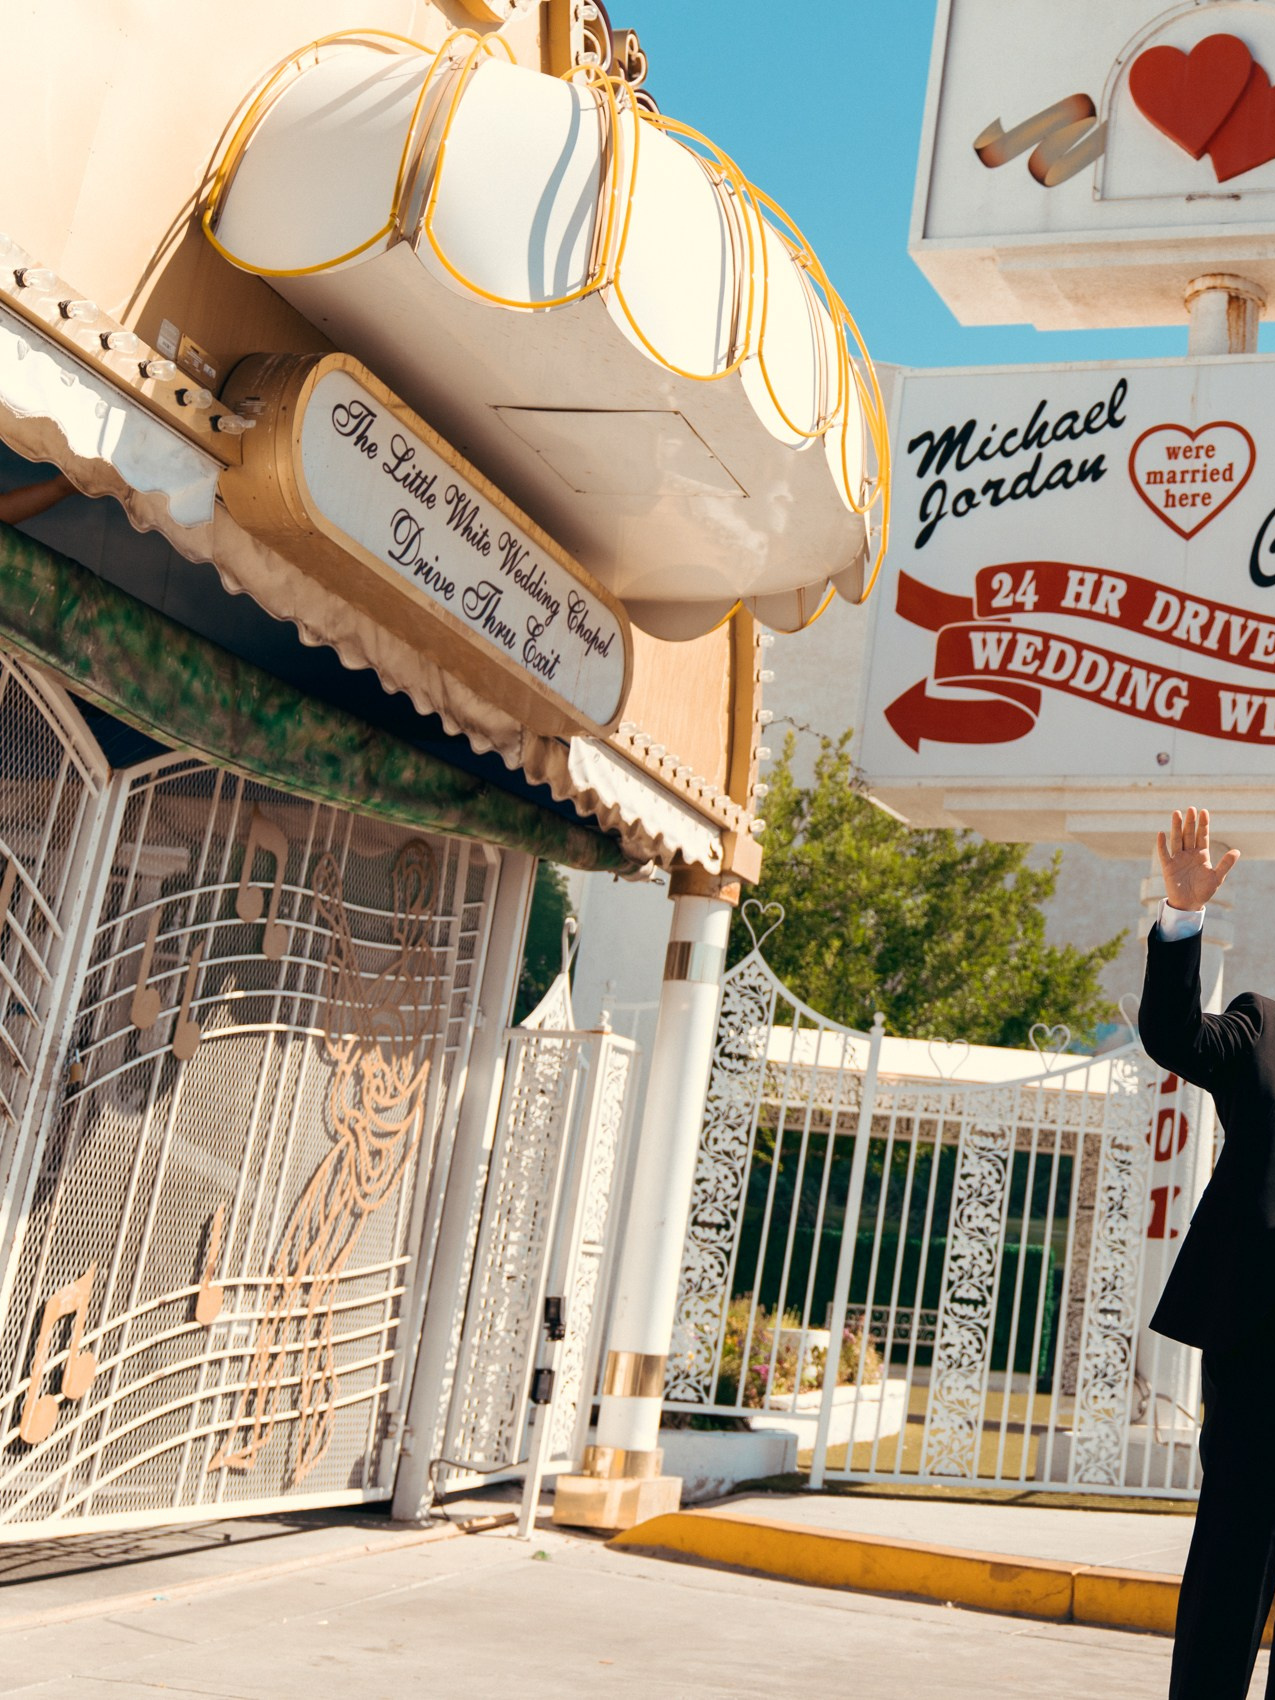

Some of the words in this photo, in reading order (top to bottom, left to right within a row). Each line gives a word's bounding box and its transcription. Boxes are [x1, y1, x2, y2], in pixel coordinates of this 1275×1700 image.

[907, 378, 1128, 479] Michael
[1146, 463, 1234, 485] married
[1165, 443, 1216, 461] were
[331, 400, 378, 460] The
[383, 434, 438, 510] Little
[444, 484, 493, 557] White
[498, 531, 561, 629] Wedding
[566, 590, 613, 659] Chapel
[914, 451, 1108, 549] Jordan
[1164, 489, 1212, 508] here
[387, 508, 457, 601] Drive
[462, 579, 516, 651] Thru
[522, 615, 561, 681] Exit
[990, 569, 1039, 611] 24
[1060, 570, 1128, 618] HR
[969, 631, 1190, 722] WEDDING
